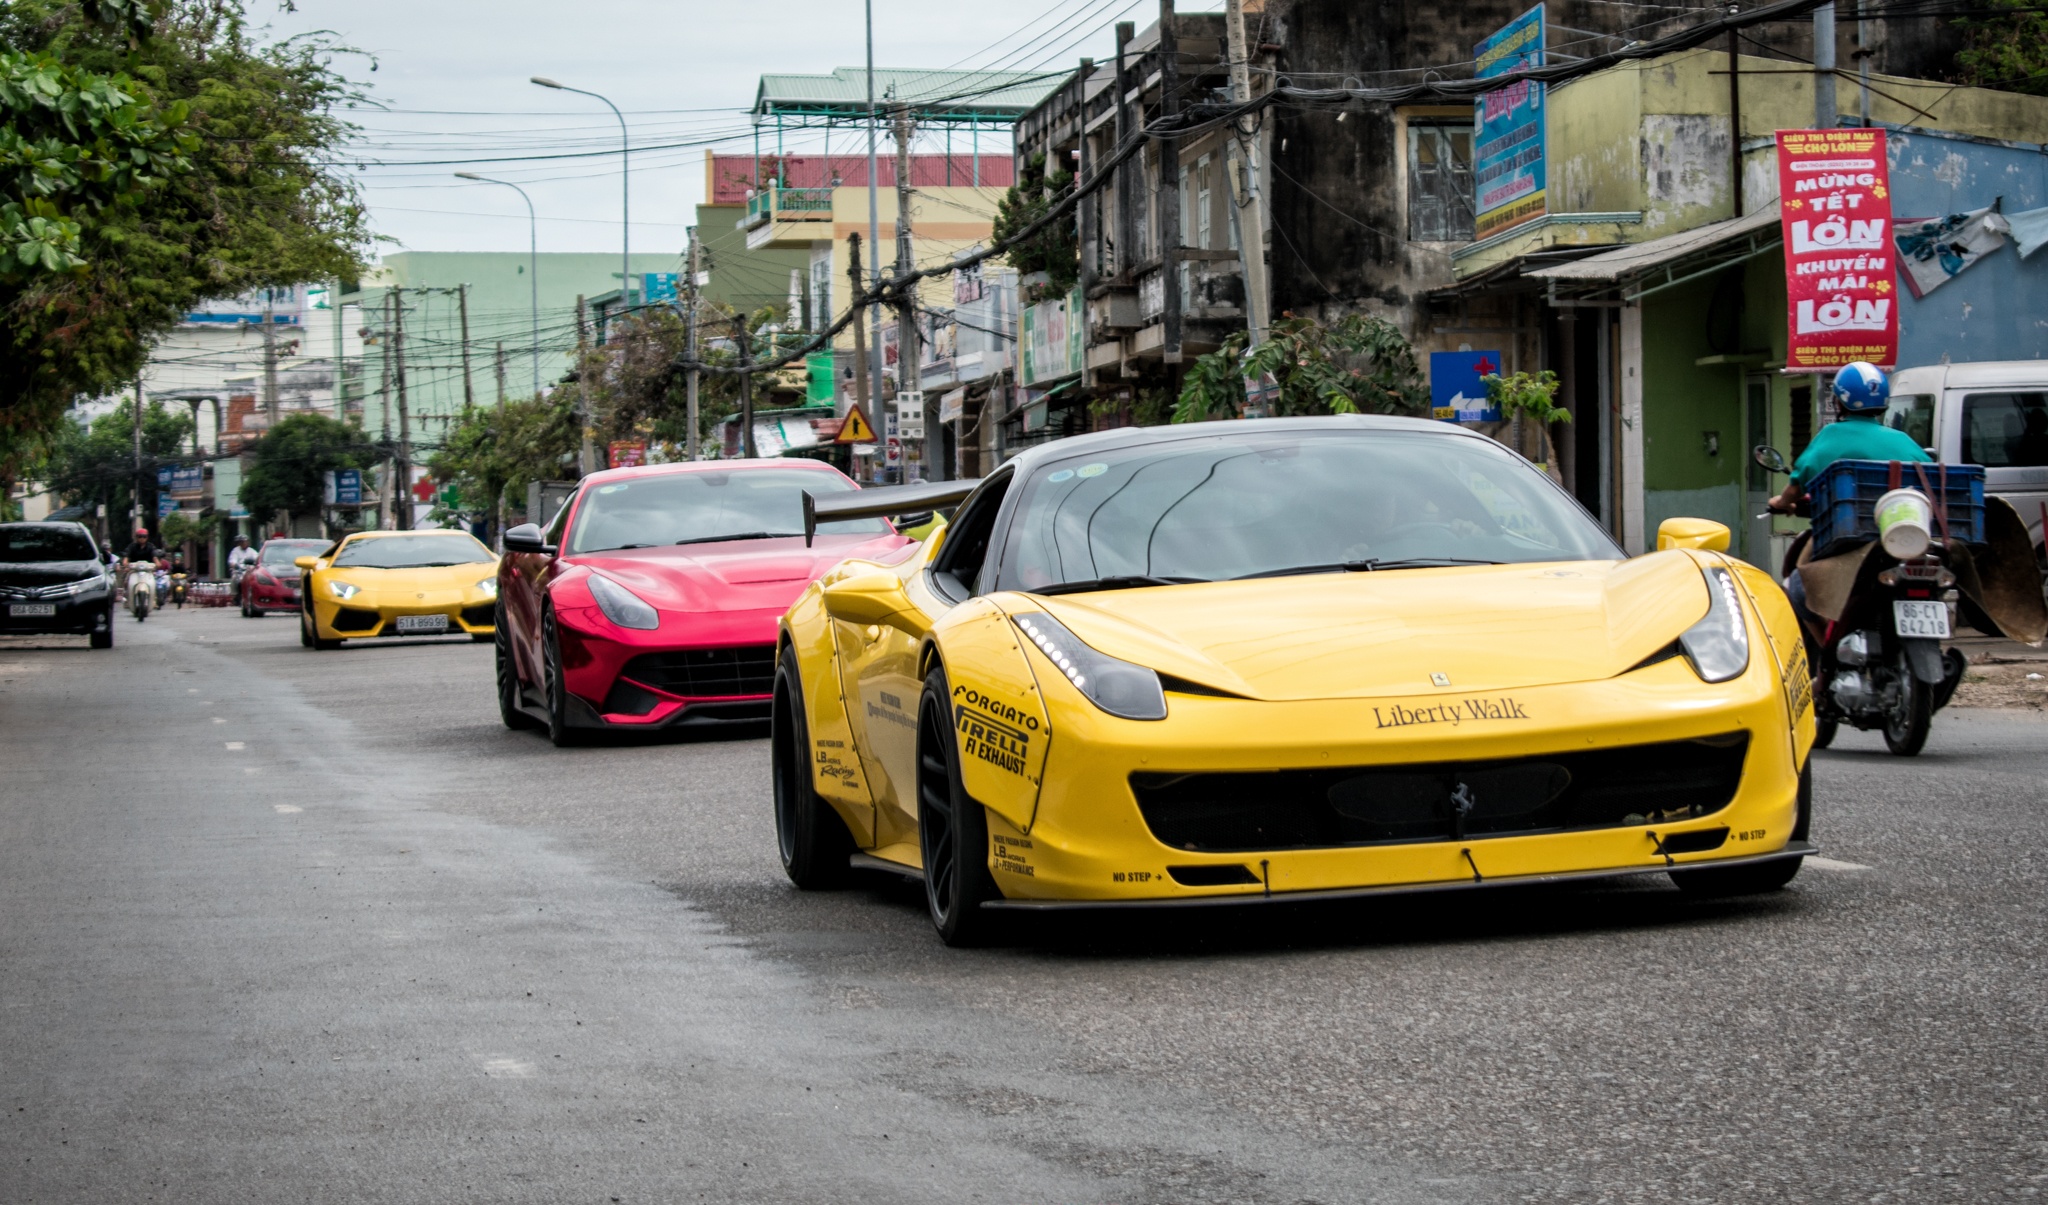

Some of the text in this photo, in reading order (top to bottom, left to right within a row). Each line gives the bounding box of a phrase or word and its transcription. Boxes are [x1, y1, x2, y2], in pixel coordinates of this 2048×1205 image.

[1783, 133, 1806, 142] SIÊU
[1808, 133, 1825, 142] THỊ
[1826, 132, 1852, 142] ĐIỆN
[1804, 141, 1856, 154] CHỢ LỚN
[1795, 173, 1874, 192] MỪNG
[1809, 189, 1864, 211] TẾT
[1791, 214, 1885, 254] LỚN
[1796, 253, 1886, 275] KHUYẾN
[1817, 273, 1867, 291] MÃI
[1797, 293, 1890, 334] LỚN
[1795, 344, 1887, 355] SIÊU THỊ ĐIỆN MÁY
[1814, 353, 1867, 366] CHỢ LỚN
[1902, 604, 1938, 619] 86-C1
[1901, 619, 1946, 634] 642.18
[953, 685, 1039, 730] FORGIATO
[1372, 698, 1531, 729] Liberty Walk
[955, 703, 1029, 759] PIRELLI
[978, 742, 1026, 776] EXHAUST
[820, 765, 855, 779] Racing
[1739, 829, 1766, 841] NO STEP
[1112, 871, 1152, 882] NO STEP
